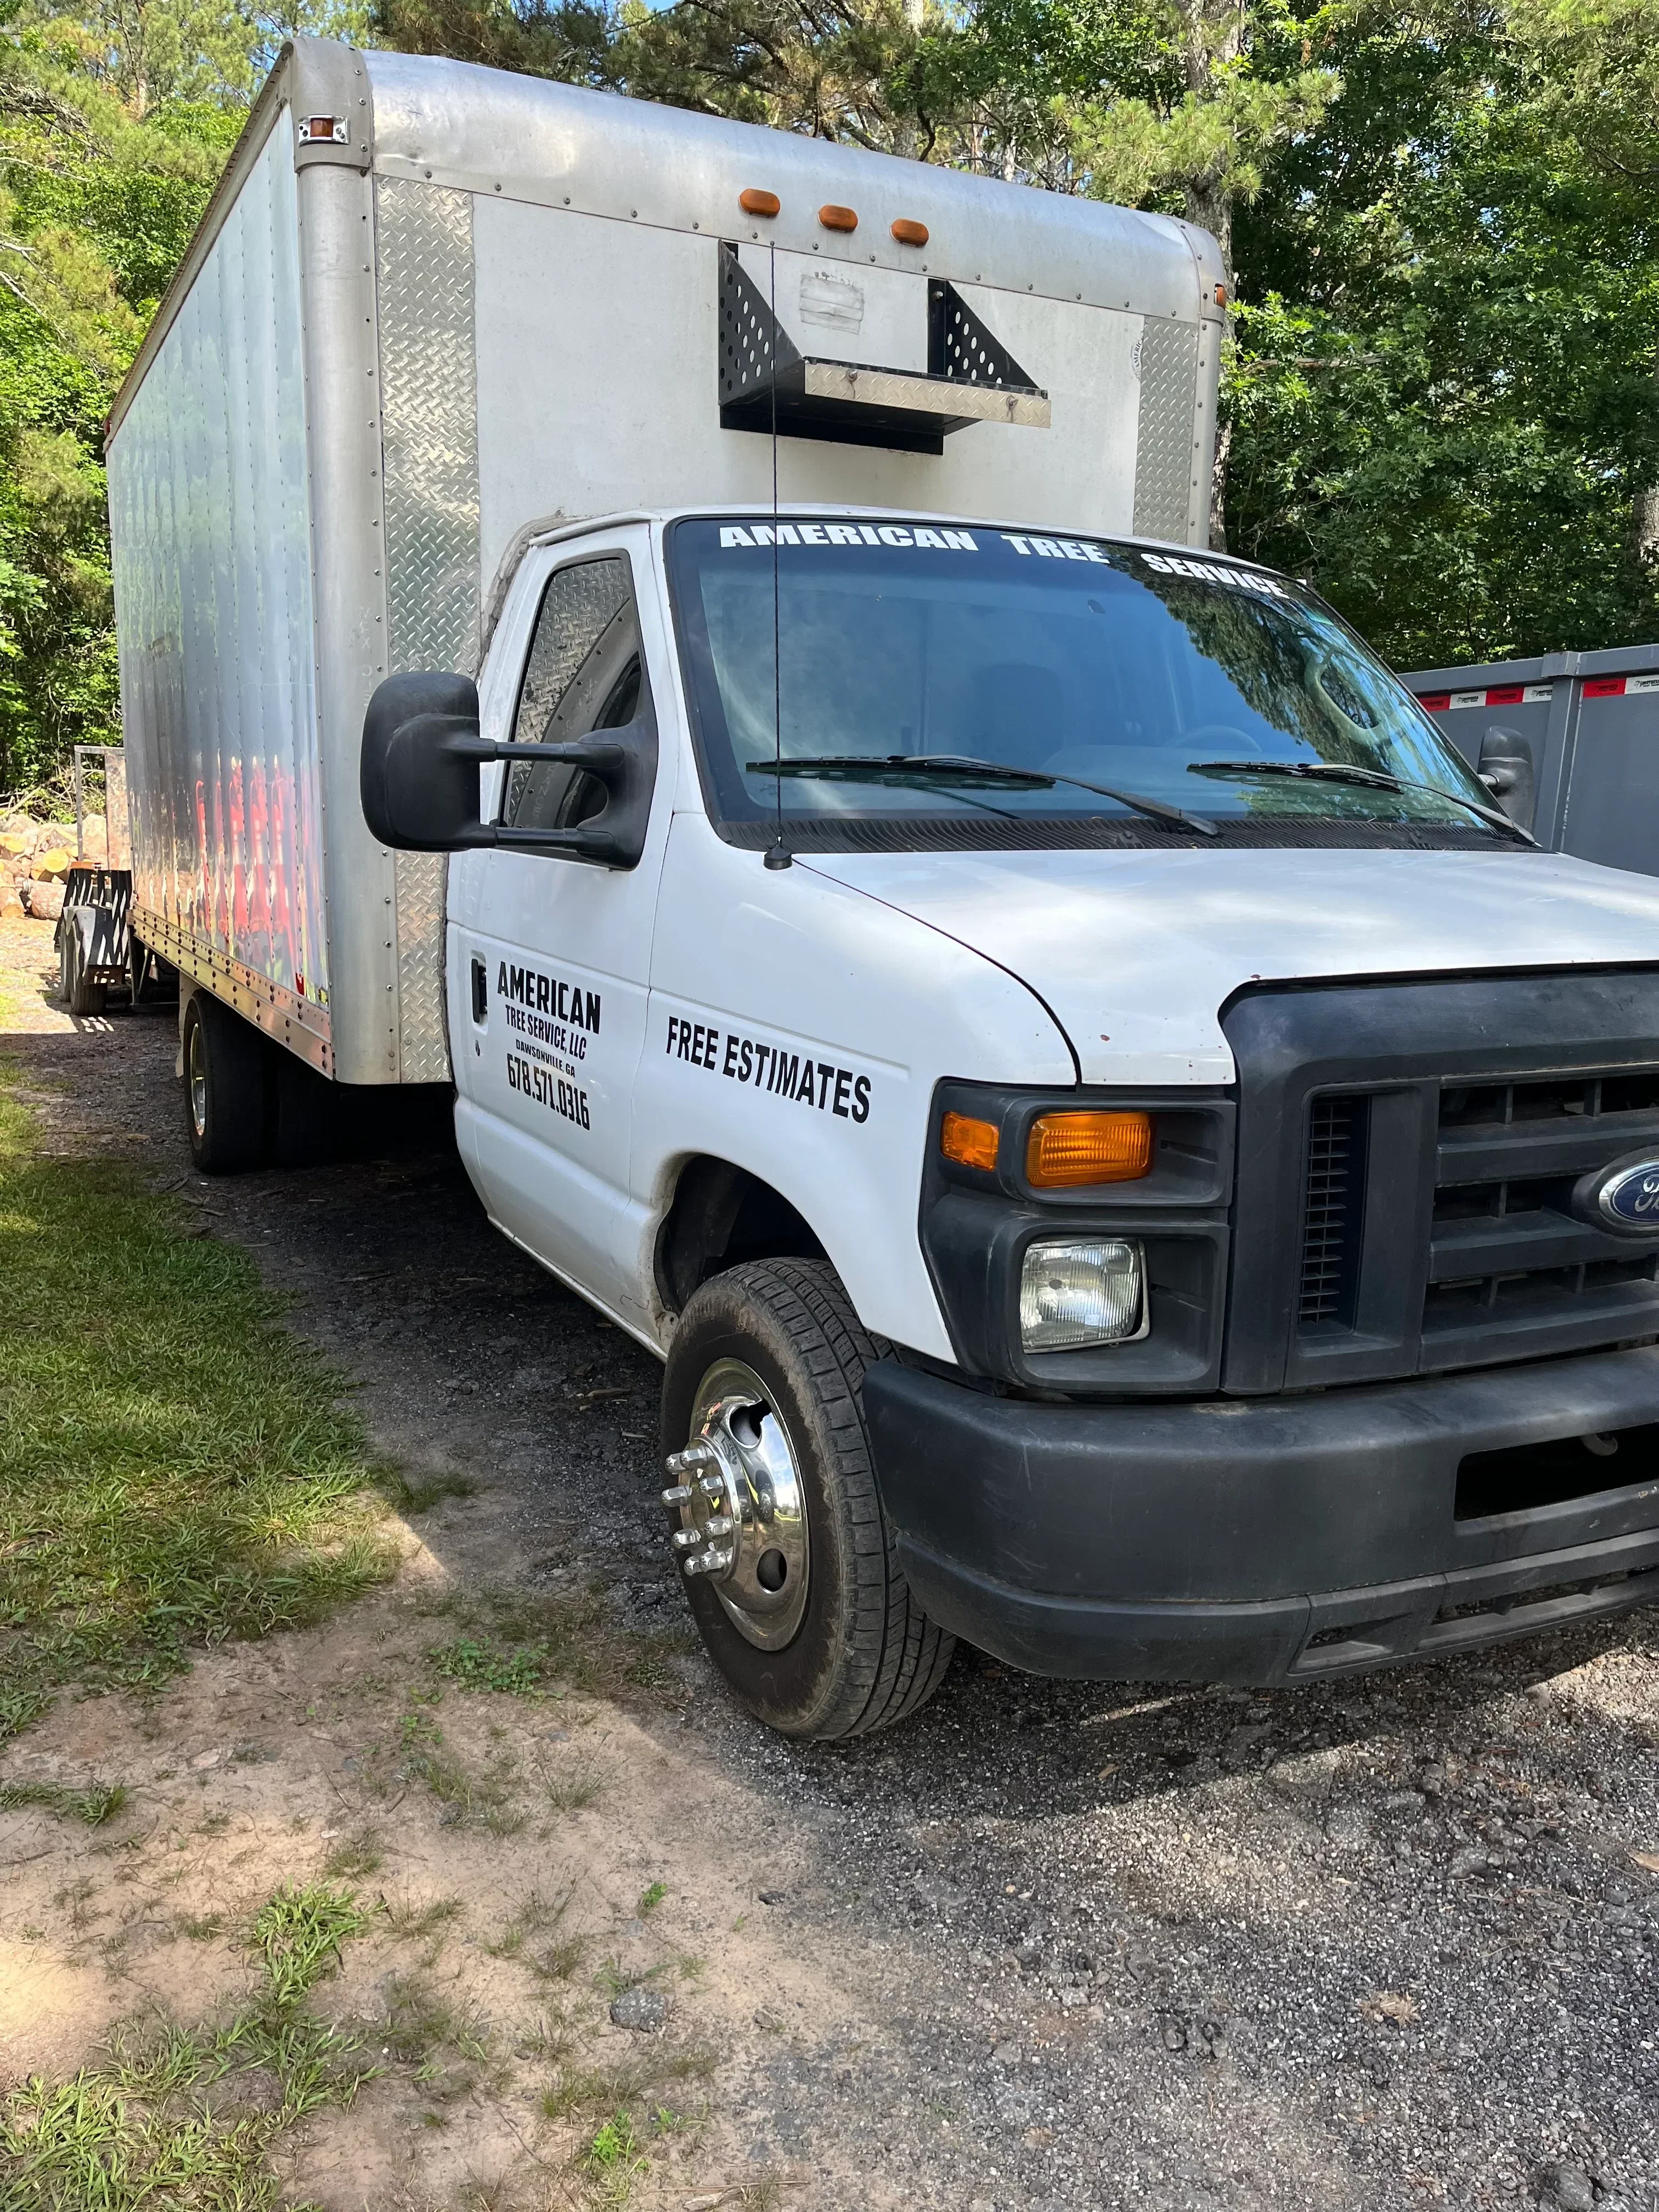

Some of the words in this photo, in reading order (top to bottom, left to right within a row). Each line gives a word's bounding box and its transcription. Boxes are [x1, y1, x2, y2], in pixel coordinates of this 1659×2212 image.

[719, 525, 979, 551] AMERICAN
[1000, 534, 1111, 564] TREE
[1140, 553, 1291, 599] SERVICE
[497, 961, 601, 1035] AMERICAN
[505, 1004, 527, 1034] TREE
[527, 1014, 568, 1056] SERVICE,
[569, 1032, 586, 1060] LLC
[507, 1053, 590, 1131] 678.571.0316
[516, 1039, 565, 1074] DAWSONVILLE,
[566, 1063, 575, 1079] GA
[667, 1016, 719, 1070] FREE
[723, 1034, 872, 1124] ESTIMATES
